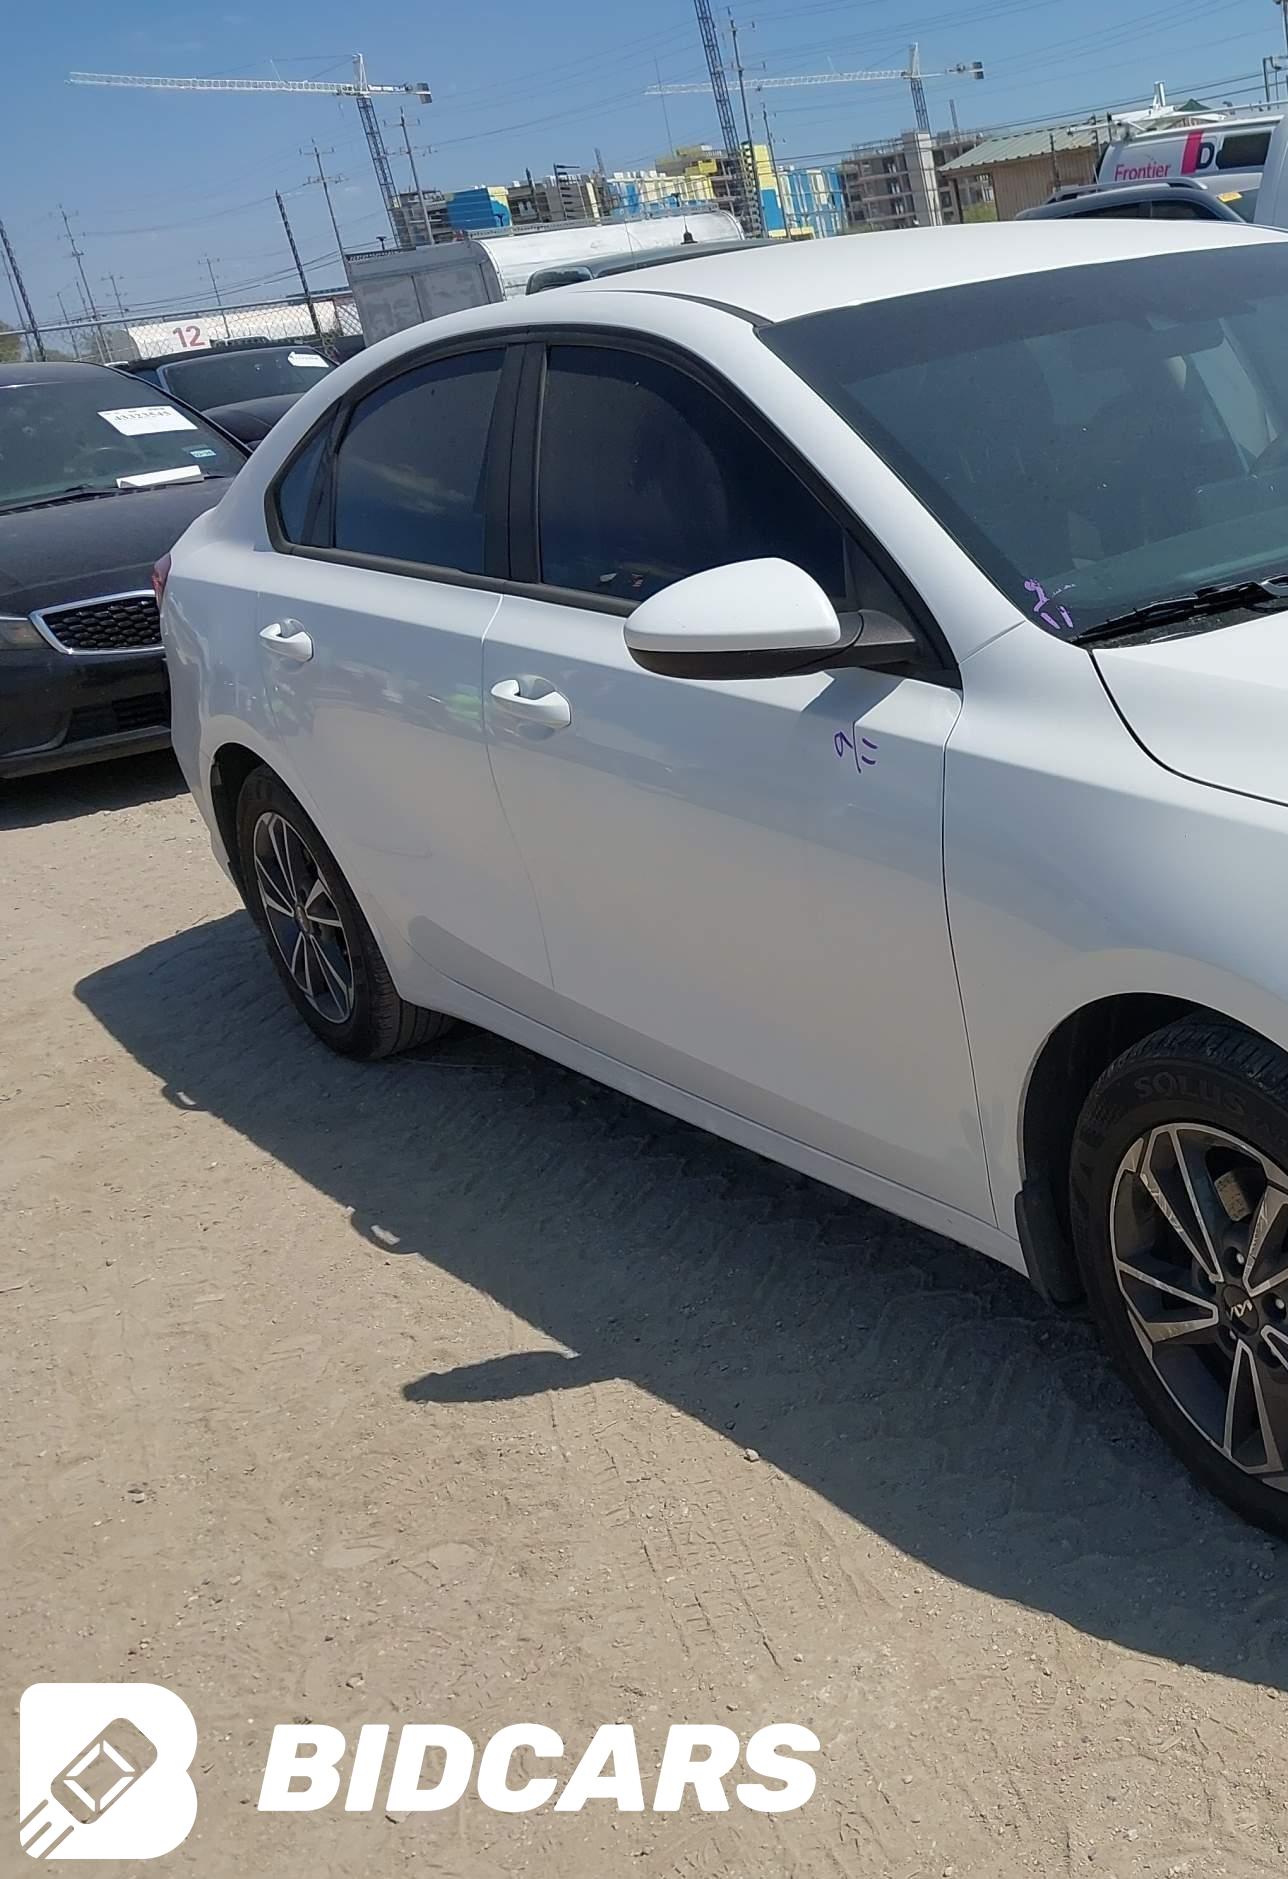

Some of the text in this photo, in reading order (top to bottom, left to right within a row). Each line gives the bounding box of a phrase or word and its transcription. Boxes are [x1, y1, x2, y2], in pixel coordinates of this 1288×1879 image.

[1114, 160, 1172, 182] Frontier
[172, 325, 206, 348] 12
[1133, 1070, 1247, 1117] SOLUS
